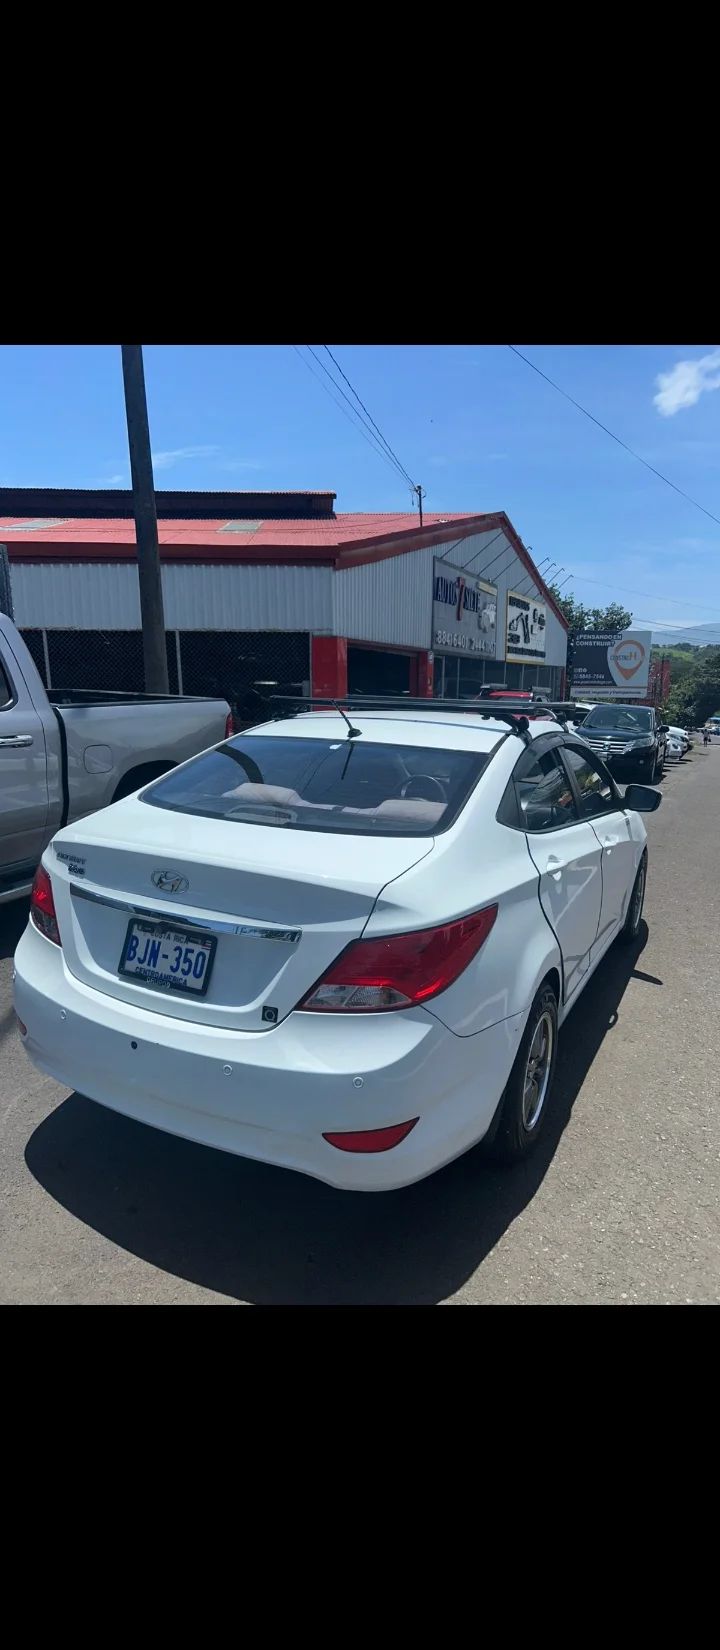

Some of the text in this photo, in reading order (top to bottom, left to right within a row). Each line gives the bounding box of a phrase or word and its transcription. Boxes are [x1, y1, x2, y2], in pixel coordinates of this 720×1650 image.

[456, 576, 466, 621] 7
[173, 934, 189, 945] RICA
[126, 934, 207, 979] BJN-350
[135, 966, 188, 987] CENTROAMERICA
